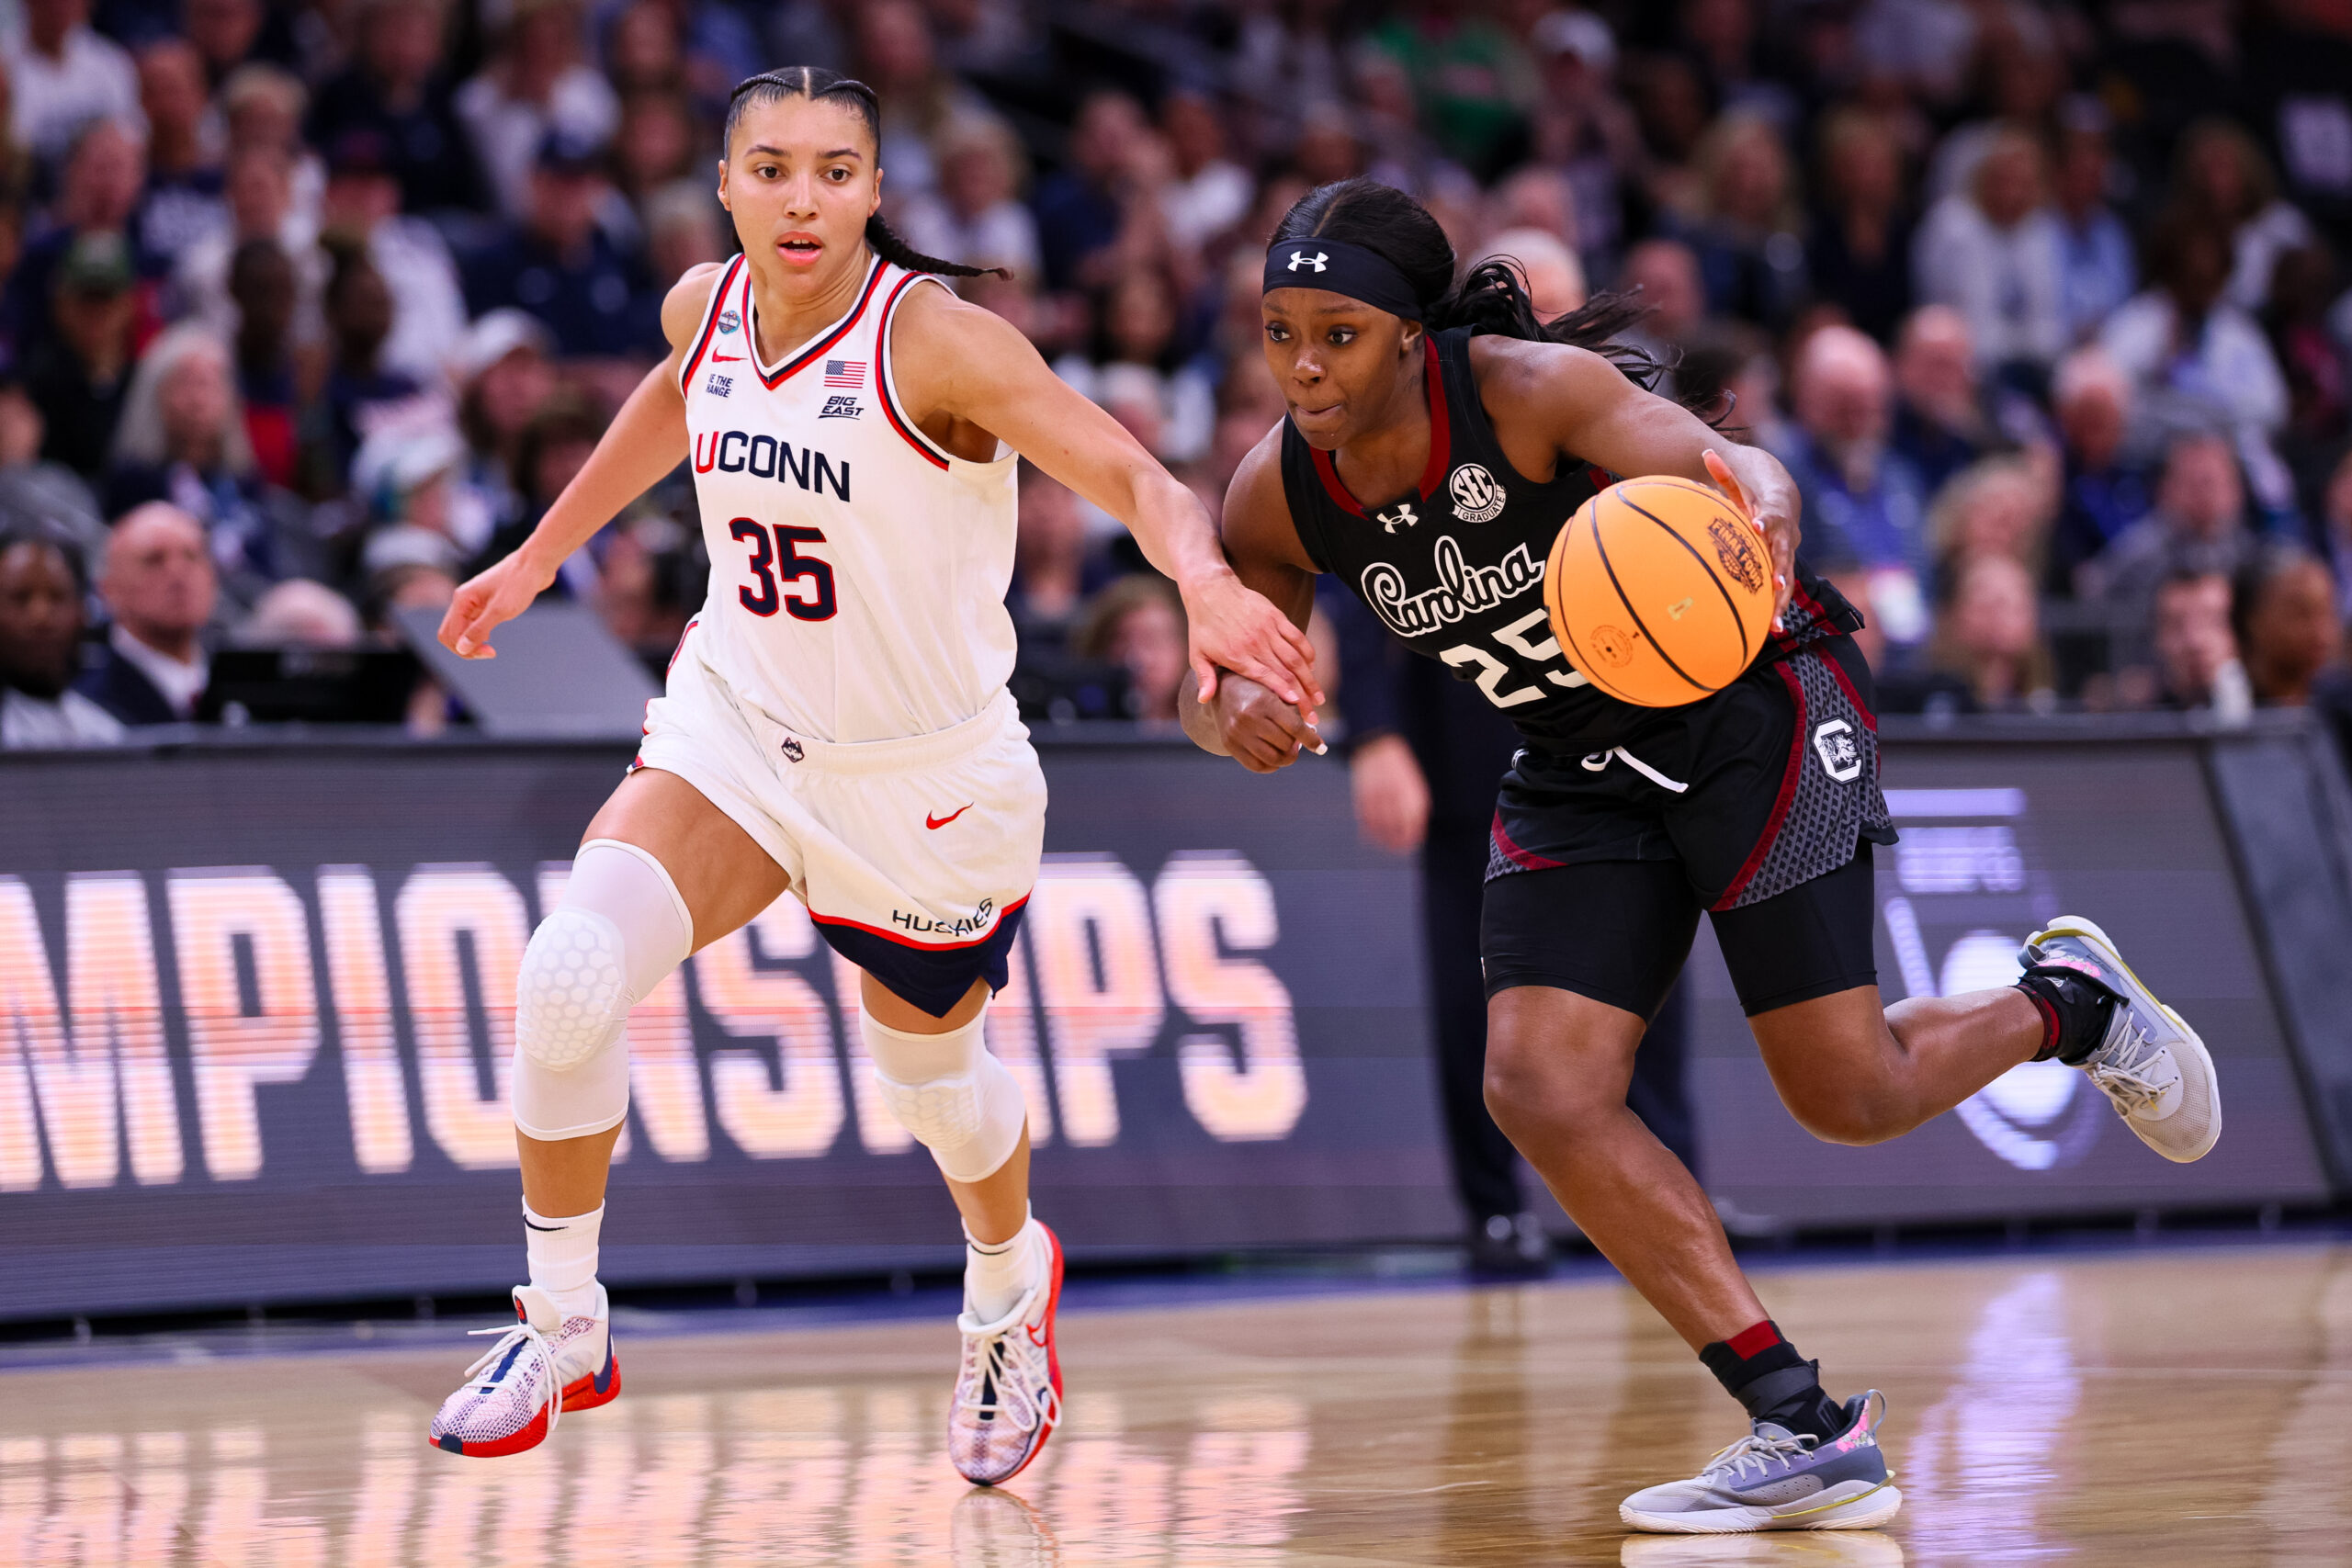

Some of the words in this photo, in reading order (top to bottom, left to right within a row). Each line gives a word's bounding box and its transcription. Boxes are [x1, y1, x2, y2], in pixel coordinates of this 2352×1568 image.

[716, 375, 733, 388] THE
[827, 395, 858, 406] BIG
[821, 405, 865, 416] EAST
[695, 430, 851, 503] UCONN
[1453, 467, 1493, 509] SEC
[1462, 495, 1505, 523] GRADUATE
[729, 516, 838, 622] 35
[1709, 518, 1746, 558] FINAL
[1739, 551, 1764, 591] FOUR
[1361, 535, 1546, 638] Carolina
[1439, 607, 1590, 709] 25
[892, 897, 993, 937] HUSKIES
